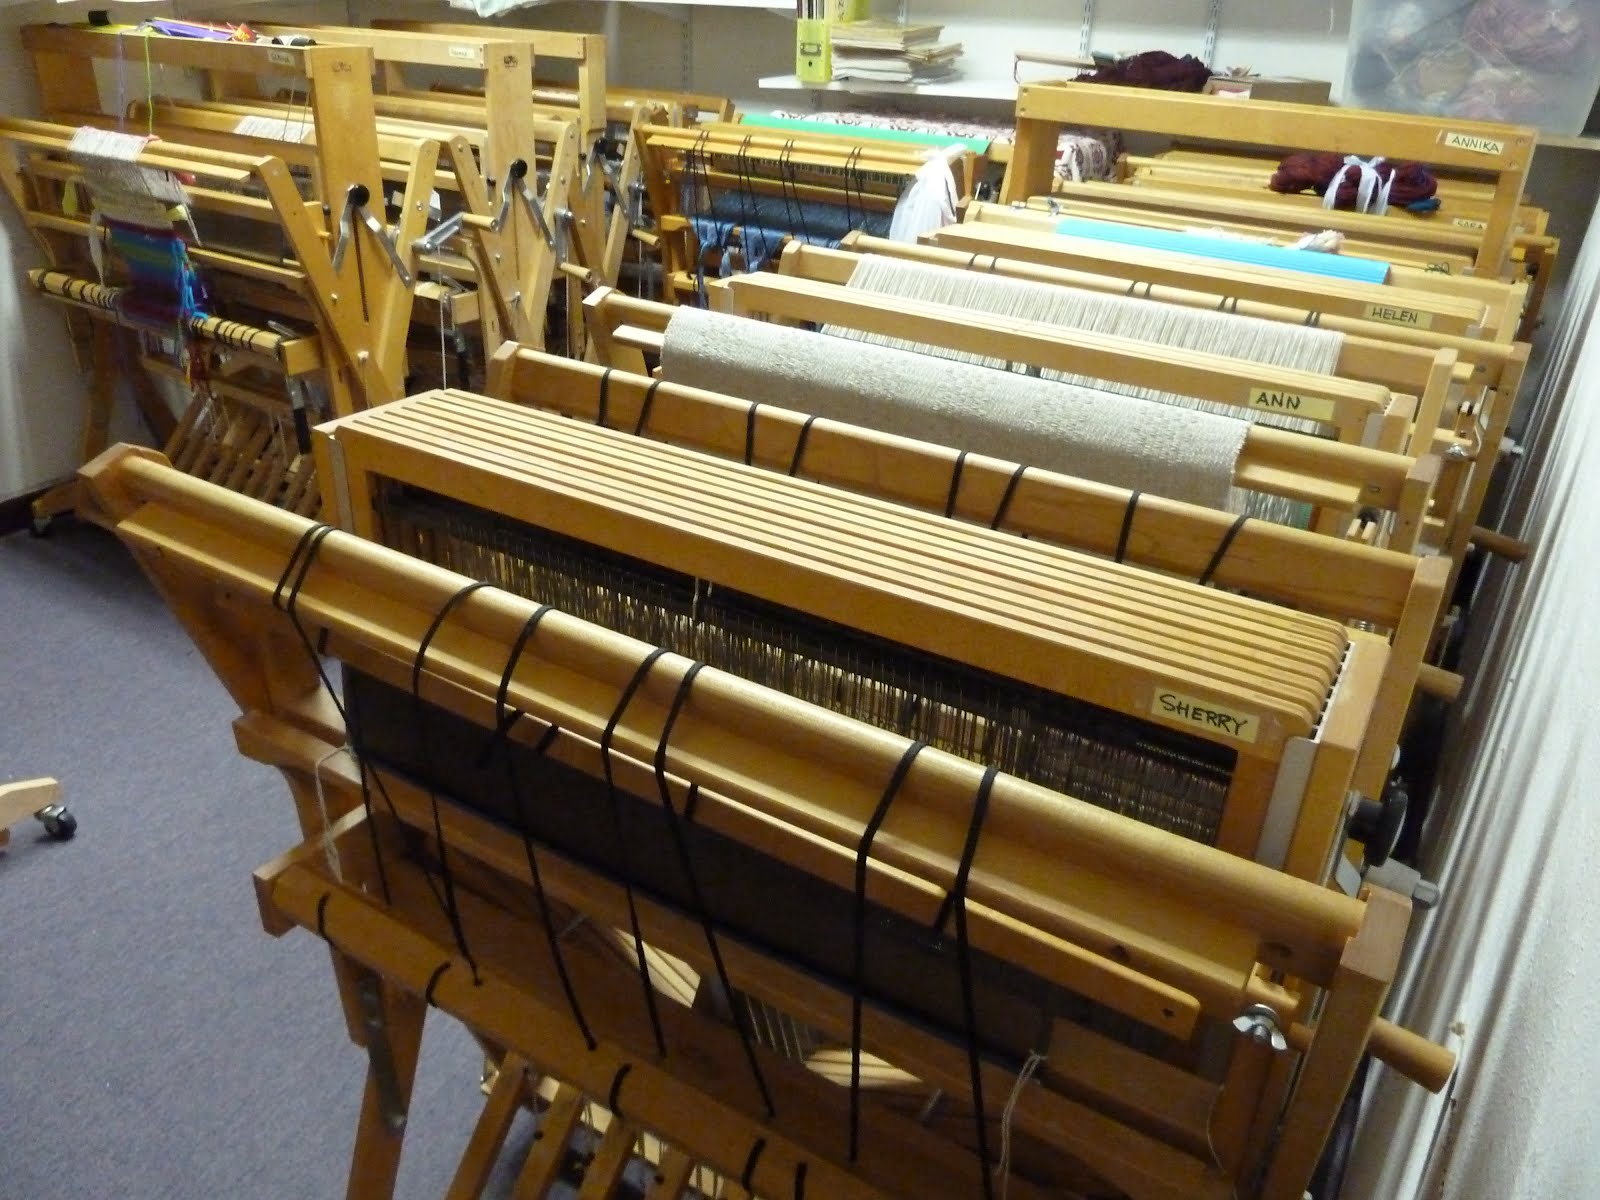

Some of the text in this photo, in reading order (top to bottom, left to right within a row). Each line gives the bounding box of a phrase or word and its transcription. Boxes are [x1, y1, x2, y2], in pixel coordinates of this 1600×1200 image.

[1451, 135, 1500, 153] ANNIKA
[1371, 307, 1418, 324] HELEN
[1256, 392, 1301, 410] ANN
[1159, 694, 1248, 735] SHERRY
